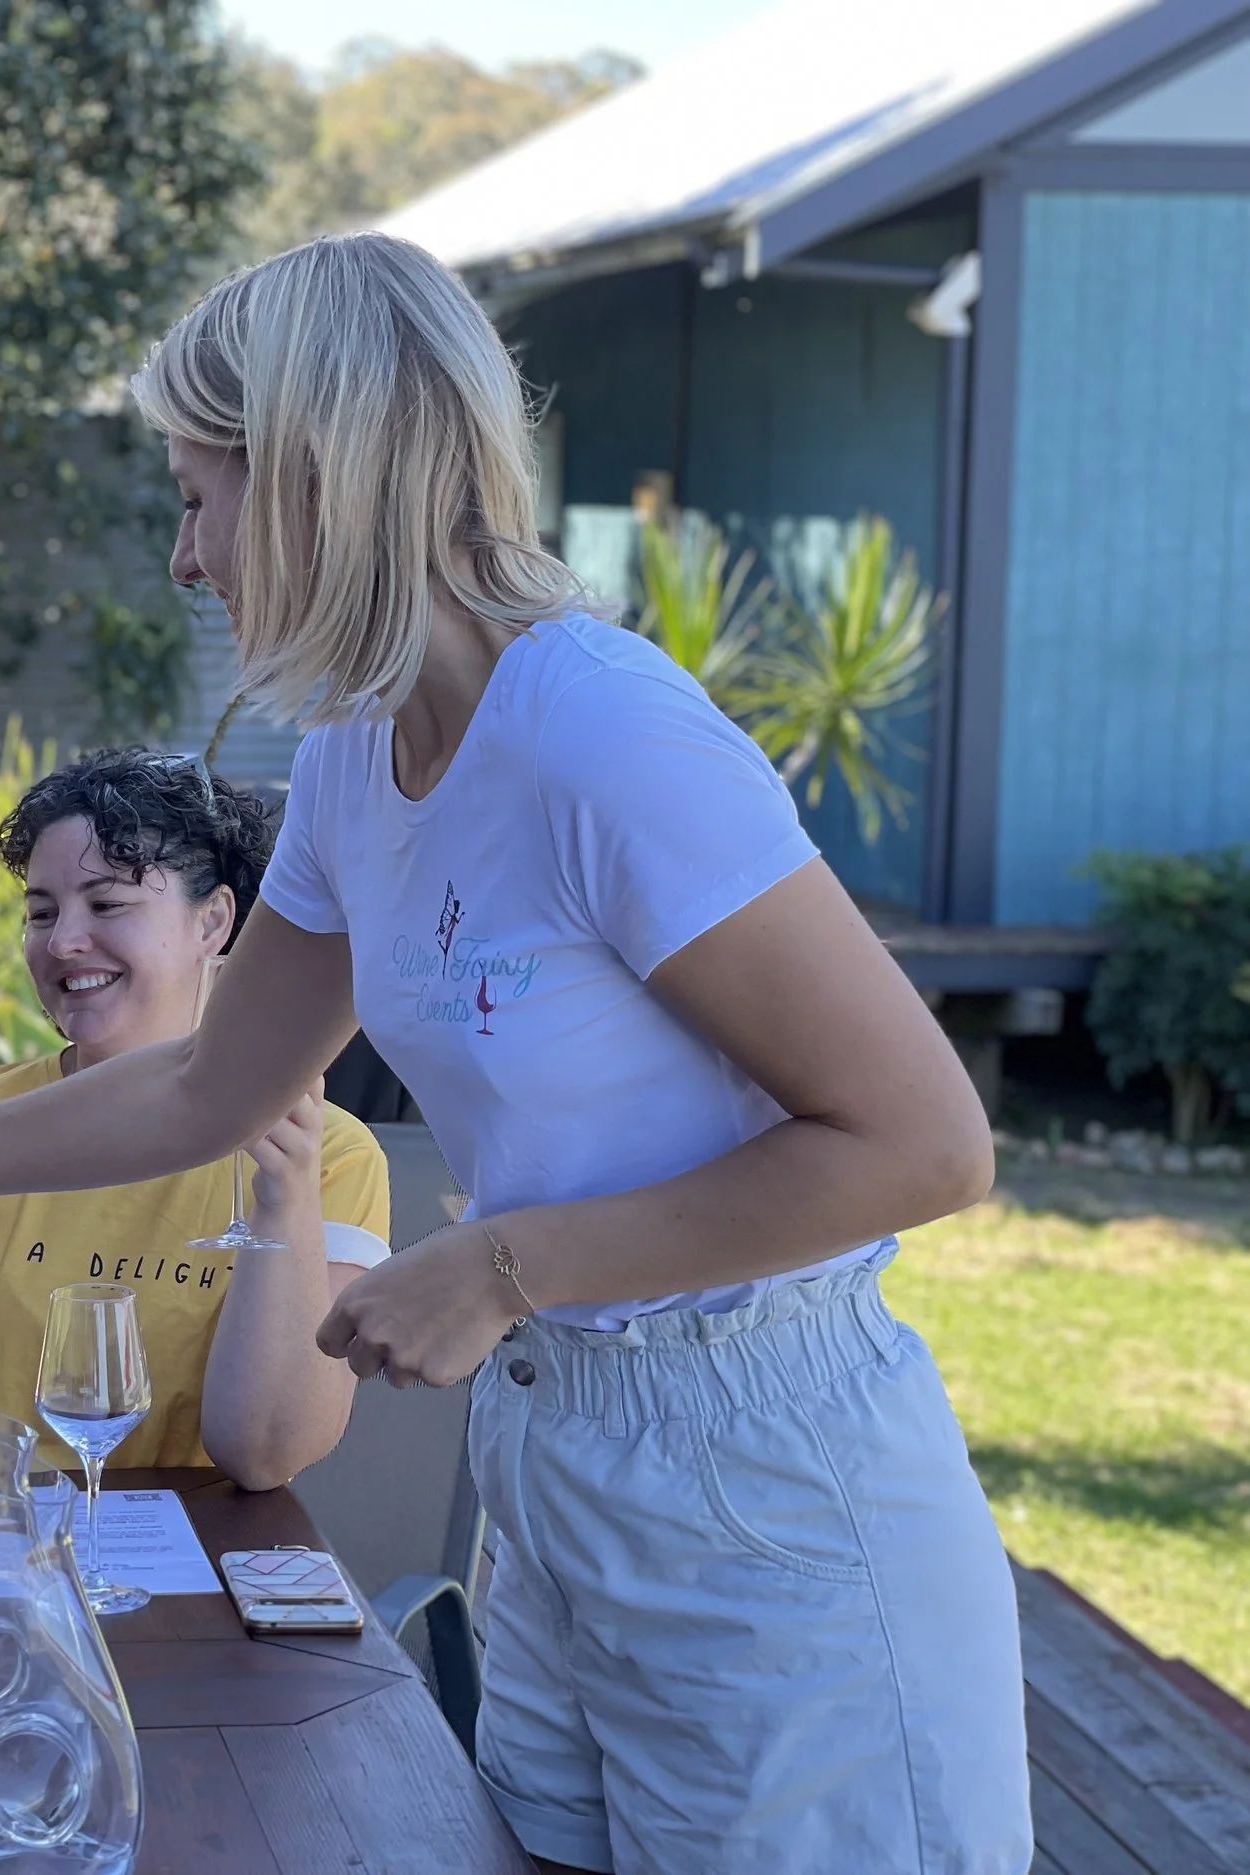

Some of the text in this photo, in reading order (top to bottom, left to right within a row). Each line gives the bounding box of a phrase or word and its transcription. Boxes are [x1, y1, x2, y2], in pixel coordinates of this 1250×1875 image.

[393, 935, 542, 998] Wine Fairy
[417, 983, 473, 1023] Events
[26, 1242, 45, 1263] A
[89, 1252, 234, 1289] DELIGH
